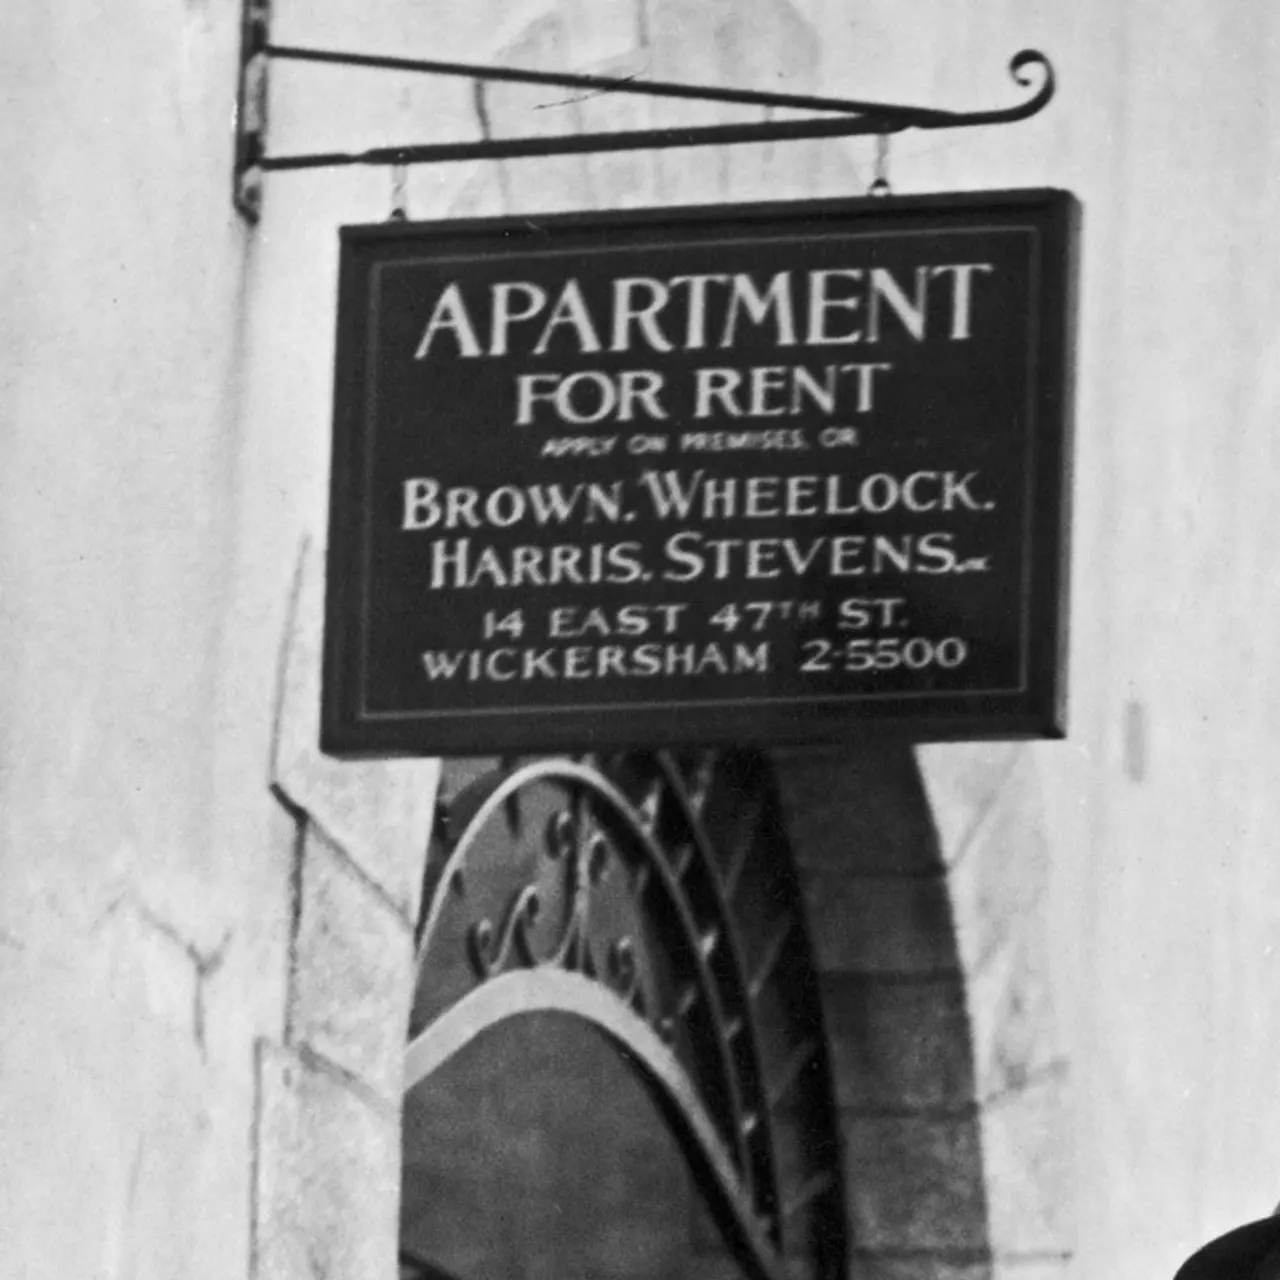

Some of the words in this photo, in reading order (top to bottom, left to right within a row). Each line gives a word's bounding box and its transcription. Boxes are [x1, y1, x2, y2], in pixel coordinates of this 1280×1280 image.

[414, 262, 993, 359] APARTMENT
[515, 369, 668, 426] FOR
[694, 362, 891, 419] RENT
[821, 427, 857, 448] OR
[484, 609, 525, 639] 14
[549, 604, 685, 638] EAST
[422, 641, 768, 681] WICKERSHAM
[800, 637, 966, 672] 2-5500
